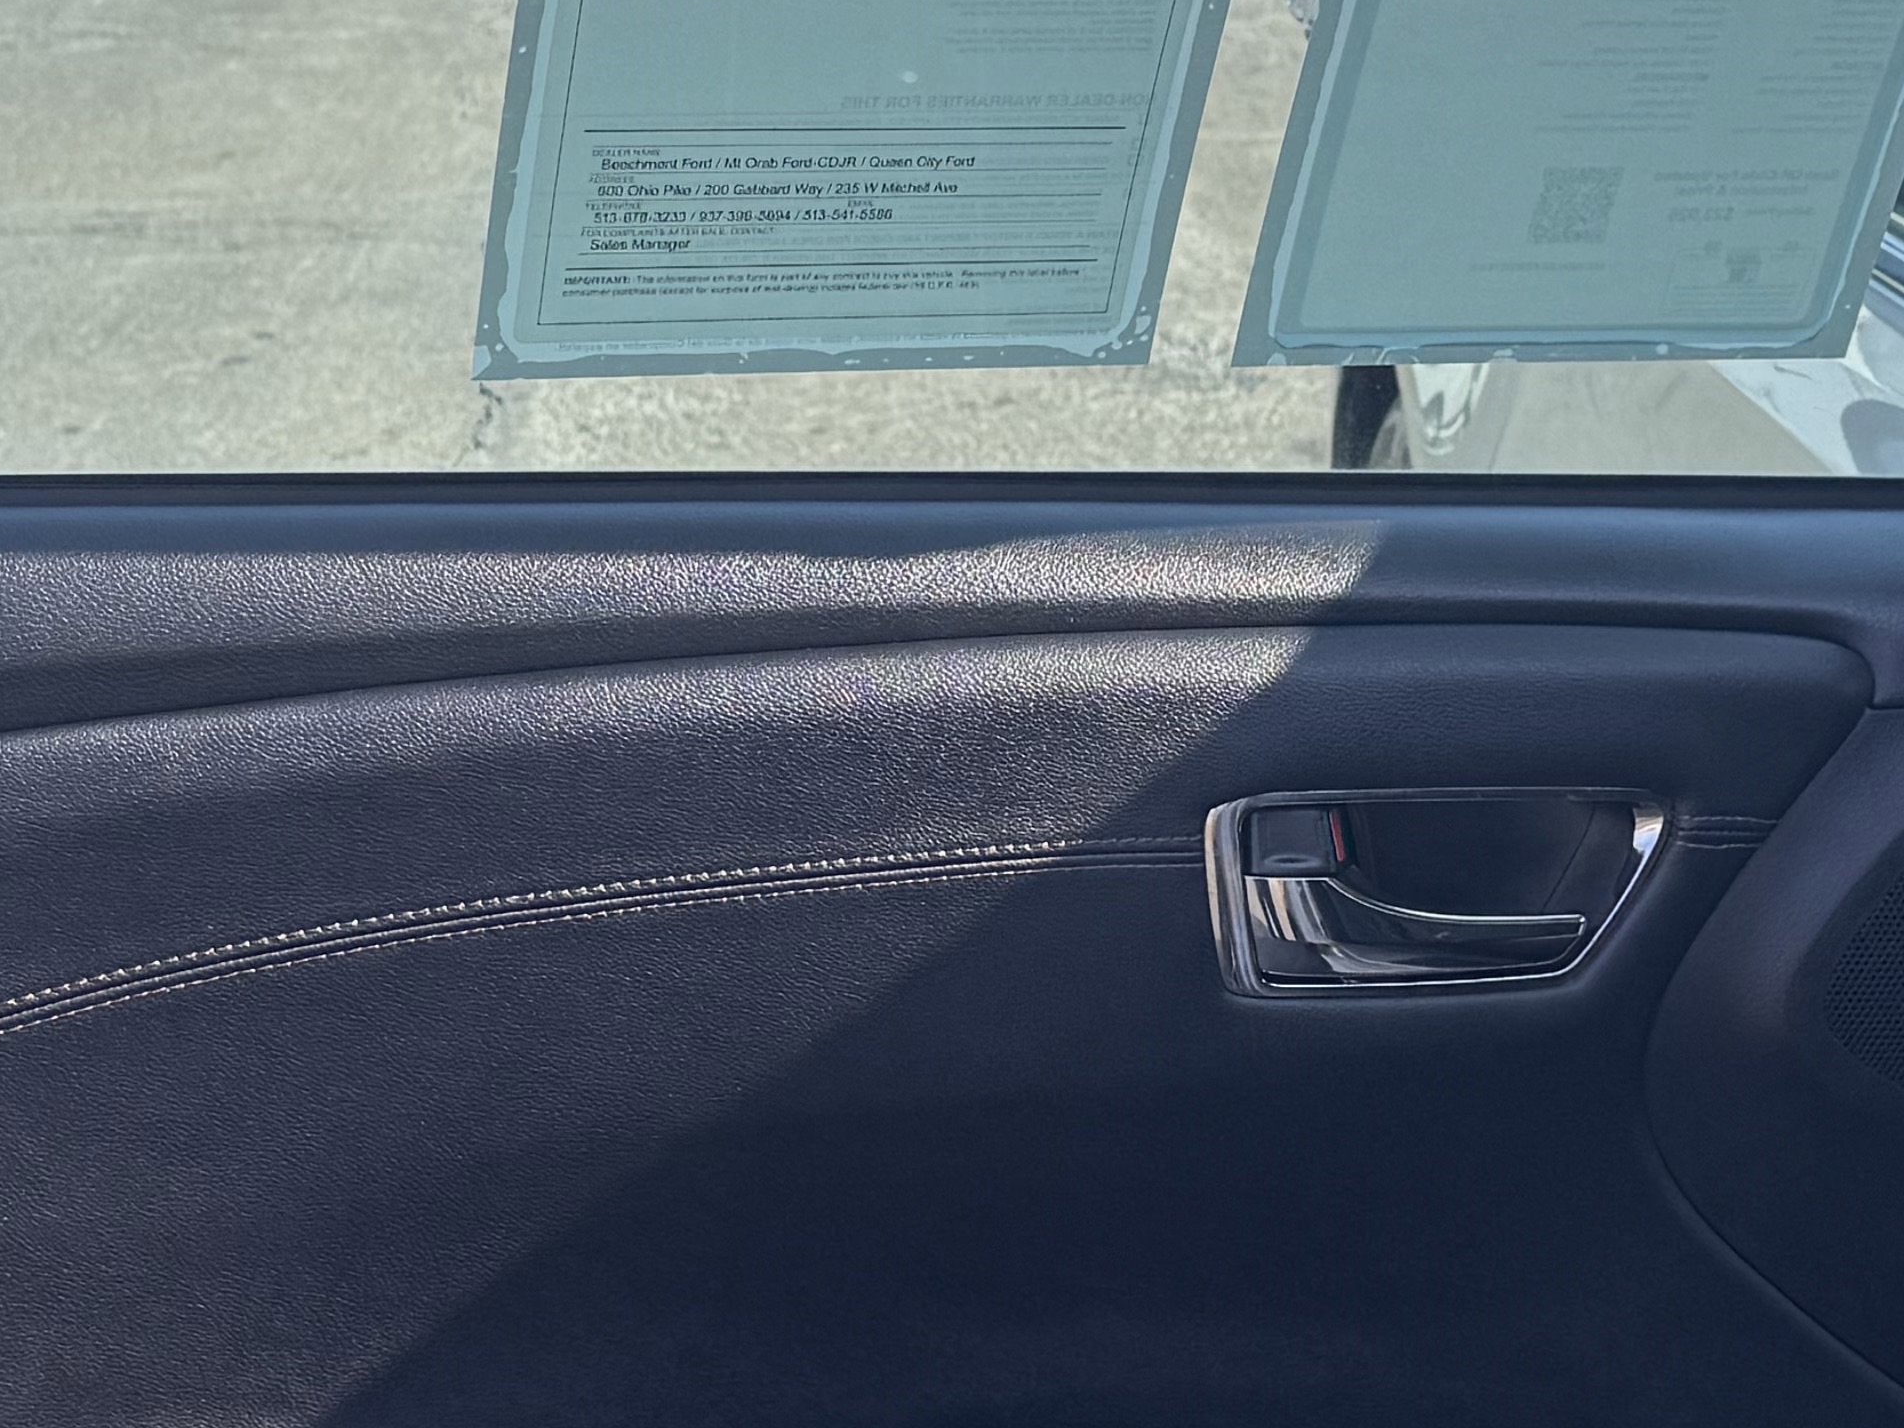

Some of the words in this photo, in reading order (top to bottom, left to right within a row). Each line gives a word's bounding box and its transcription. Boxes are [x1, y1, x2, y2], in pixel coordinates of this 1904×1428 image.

[681, 157, 712, 170] Ford
[869, 156, 913, 169] Queen
[916, 155, 943, 171] City
[945, 155, 976, 168] Ford
[627, 184, 660, 197] Ohio
[703, 184, 730, 196] 200
[794, 183, 824, 198] Way
[834, 183, 860, 195] 235
[863, 183, 879, 194] W
[590, 239, 628, 250] Sales
[631, 238, 691, 252] Manager
